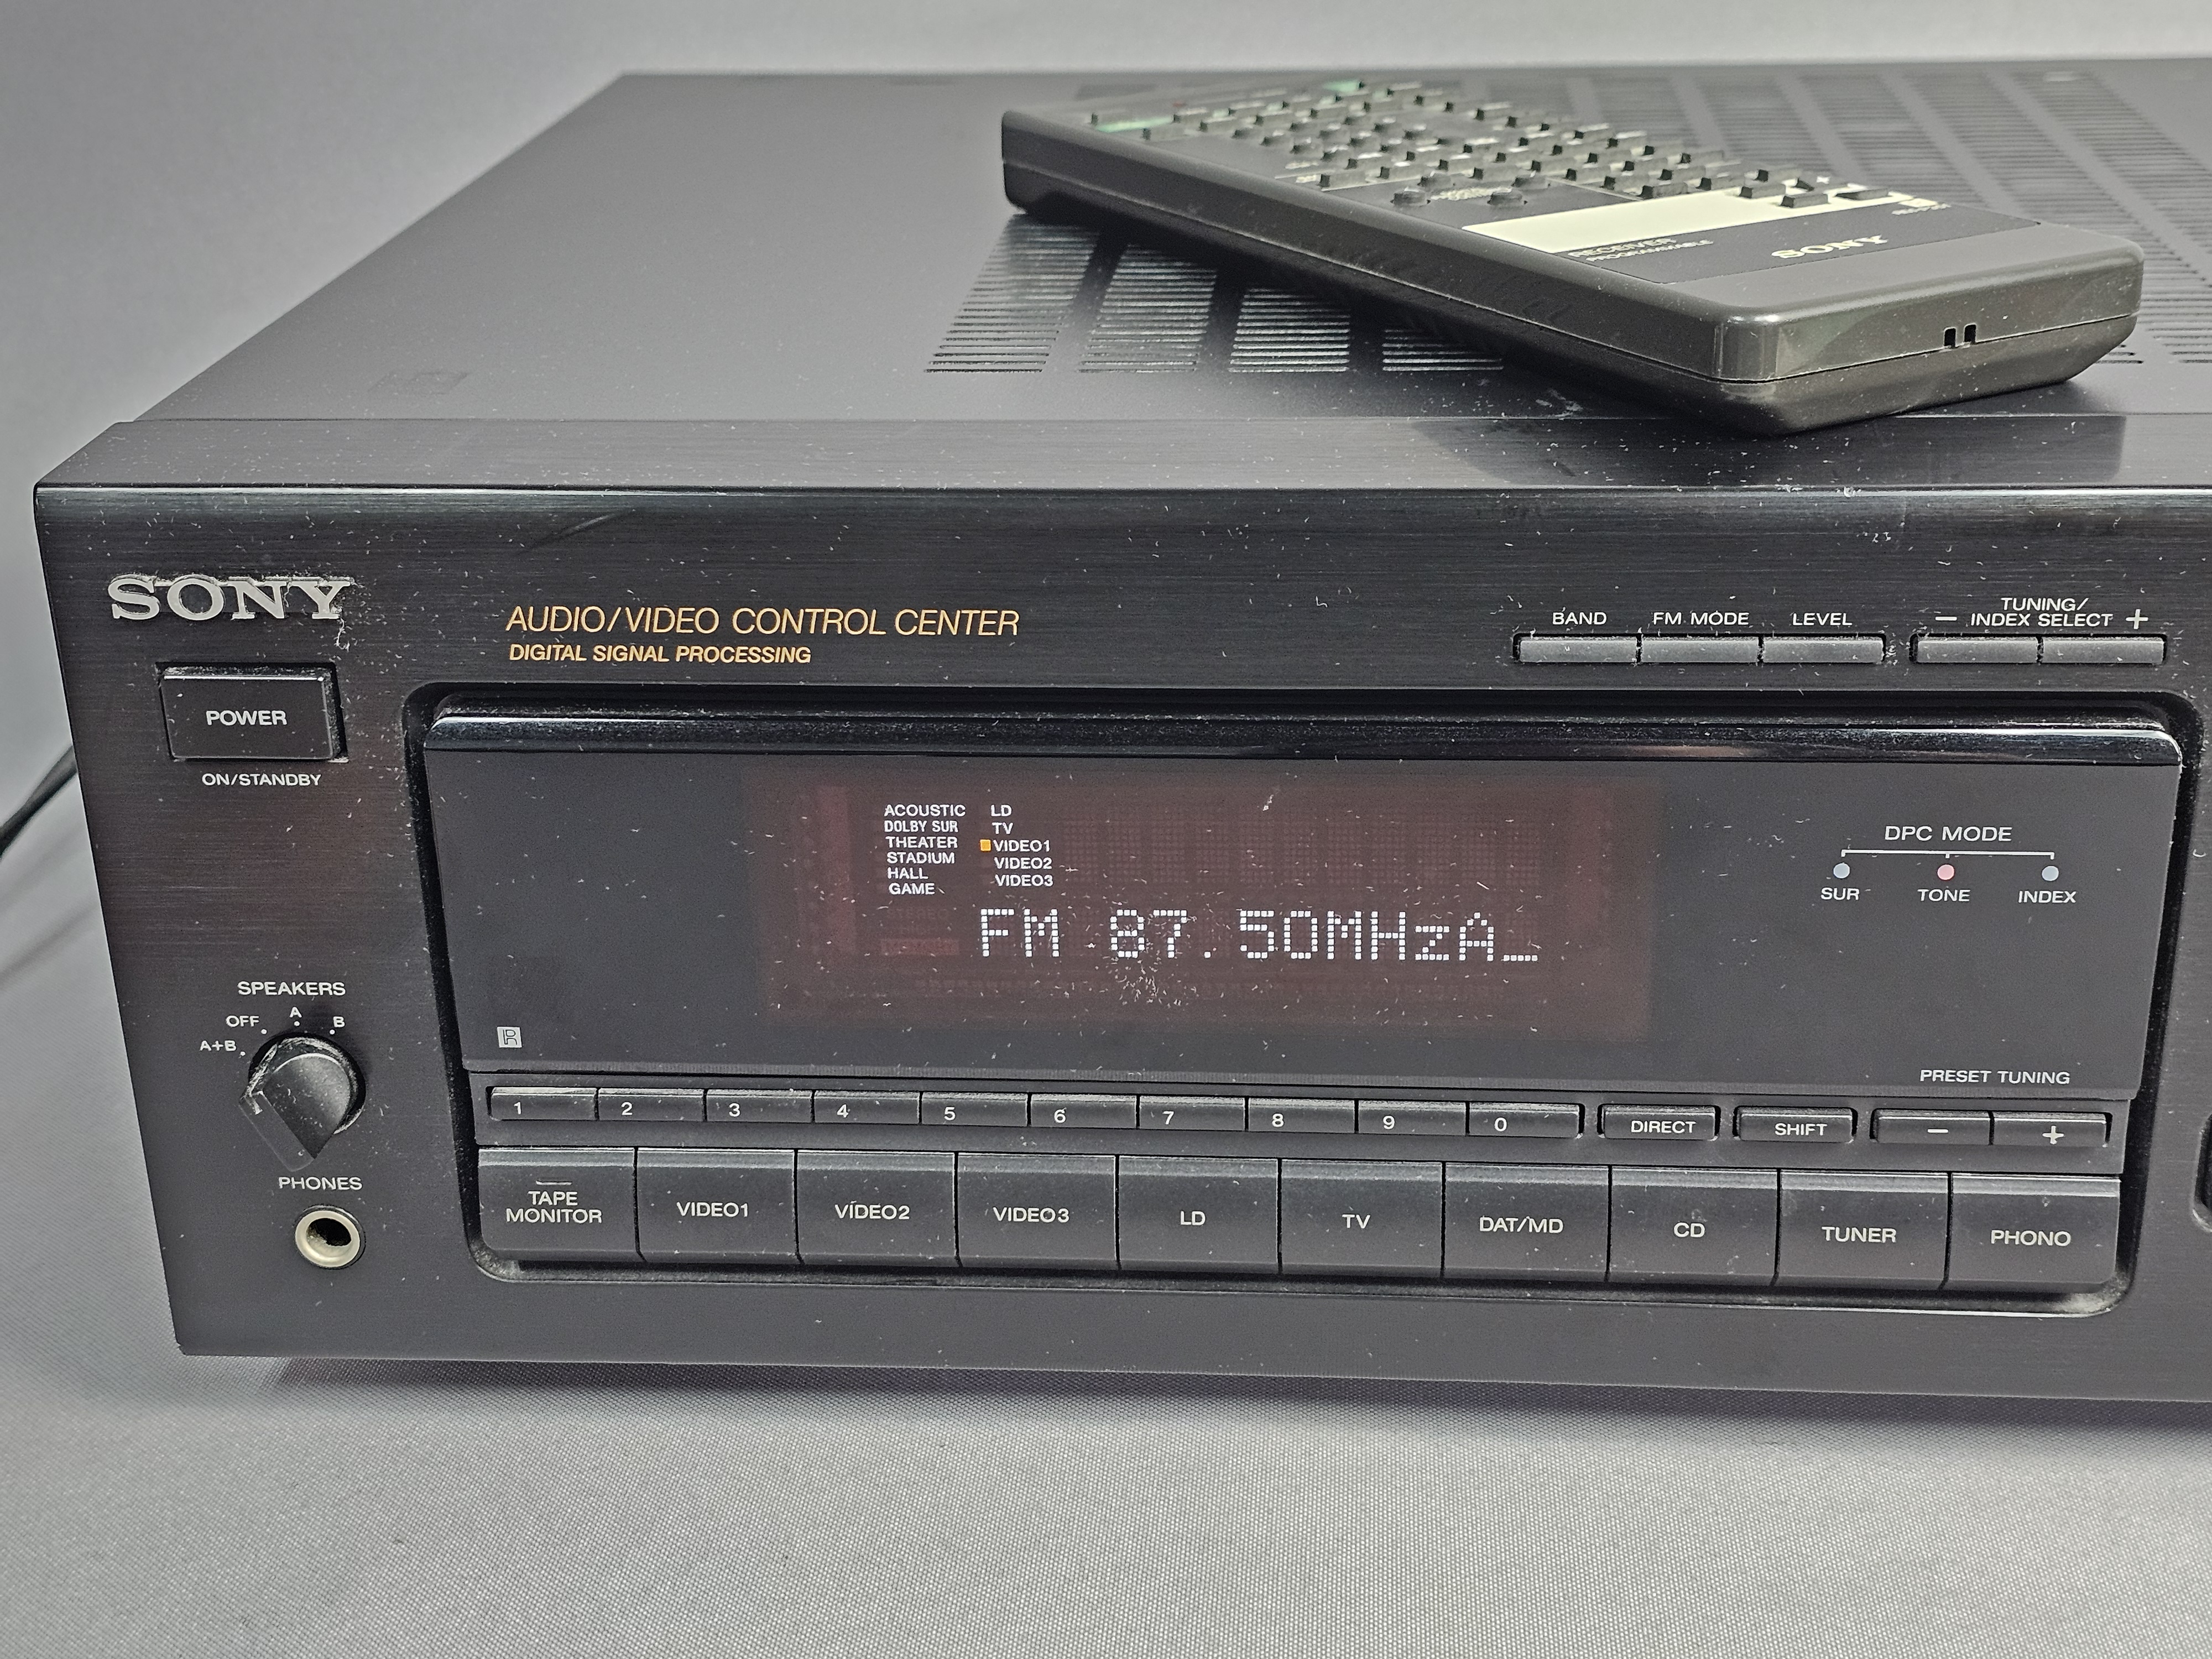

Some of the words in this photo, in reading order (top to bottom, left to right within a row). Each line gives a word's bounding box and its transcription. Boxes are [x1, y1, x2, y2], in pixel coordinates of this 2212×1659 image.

[1772, 235, 1887, 258] SONY
[108, 574, 352, 620] SONY
[2001, 598, 2089, 612] TUNING/
[505, 606, 719, 633] AUDIO/VIDEO
[733, 608, 886, 634] CONTROL
[895, 609, 1019, 635] CENTER
[1553, 612, 1606, 624] BAND
[1652, 612, 1681, 624] FM
[1691, 612, 1749, 625] MODE
[1793, 613, 1853, 625] LEVEL
[1971, 613, 2031, 626] INDEX
[2038, 613, 2113, 627] SELECT
[510, 644, 587, 661] DIGITAL
[593, 645, 669, 661] SIGNAL
[676, 646, 811, 663] PROCESSING
[206, 711, 287, 726] POWER
[202, 773, 321, 786] ON/STANDBY
[884, 805, 965, 816] ACOUSTIC
[991, 805, 1011, 816] LD
[884, 821, 927, 832] DOLBY
[932, 821, 958, 832] SUR
[992, 822, 1013, 834] TV
[1885, 826, 1932, 841] DPC
[1942, 827, 2012, 841] MODE
[885, 836, 957, 848] THEATER
[993, 840, 1050, 852] VIDEO1
[887, 852, 954, 864] STADIUM
[994, 857, 1052, 869] VIDEO2
[888, 867, 928, 879] HALL
[995, 874, 1053, 886] VIDEO3
[889, 883, 935, 895] GAME
[1821, 888, 1859, 900] SUR
[1918, 889, 1970, 901] TONE
[2018, 891, 2076, 902] INDEX
[981, 909, 1059, 957] FM
[237, 982, 345, 995] SPEAKERS
[290, 1007, 302, 1018] A
[226, 1016, 259, 1027] OFF
[333, 1016, 345, 1027] B
[200, 1040, 236, 1051] A+B
[1921, 1070, 1991, 1082] PRESET
[1997, 1071, 2069, 1084] TUNING
[514, 1102, 521, 1114] 1
[622, 1102, 632, 1115] 2
[729, 1103, 740, 1117] 3
[837, 1104, 848, 1118] 4
[945, 1107, 955, 1120] 5
[1054, 1108, 1066, 1123] 6
[1163, 1111, 1173, 1124] 7
[1272, 1114, 1284, 1127] 8
[1383, 1116, 1395, 1129] 9
[1494, 1118, 1506, 1131] 0
[1631, 1120, 1696, 1133] DIRECT
[1775, 1123, 1827, 1135] SHIFT
[279, 1177, 362, 1190] PHONES
[528, 1191, 577, 1205] TAPE
[507, 1208, 602, 1223] MONITOR
[677, 1202, 748, 1217] VIDEO1
[835, 1204, 909, 1219] VIDEO2
[993, 1207, 1069, 1222] VIDEO3
[1181, 1211, 1205, 1225] LD
[1342, 1214, 1370, 1228] TV
[1480, 1215, 1563, 1233] DAT/MD
[1674, 1223, 1705, 1237] CD
[1822, 1227, 1896, 1243] TUNER
[1991, 1230, 2071, 1246] PHONO
